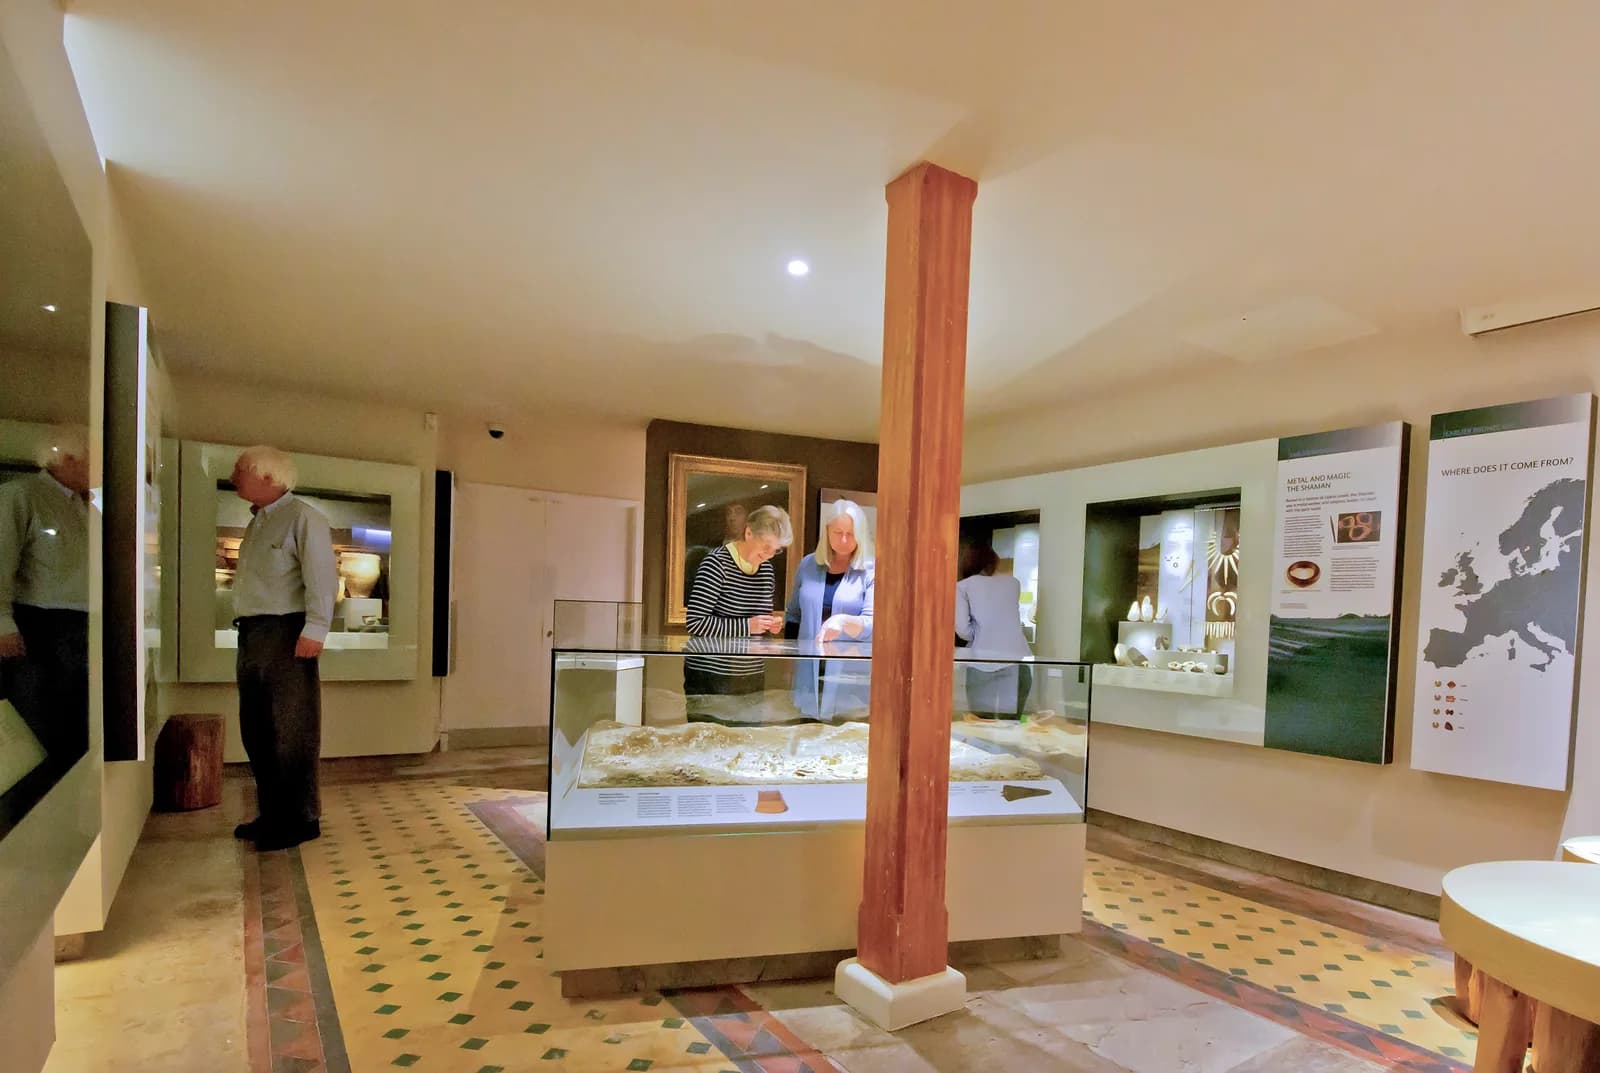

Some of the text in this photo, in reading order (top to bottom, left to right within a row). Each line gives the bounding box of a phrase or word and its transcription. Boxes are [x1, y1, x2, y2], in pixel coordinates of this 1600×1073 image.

[1441, 457, 1574, 476] WHERE DOES IT COME FROM?
[1287, 472, 1351, 485] METAL AND MAGIC
[1300, 482, 1331, 490] SHAMAN
